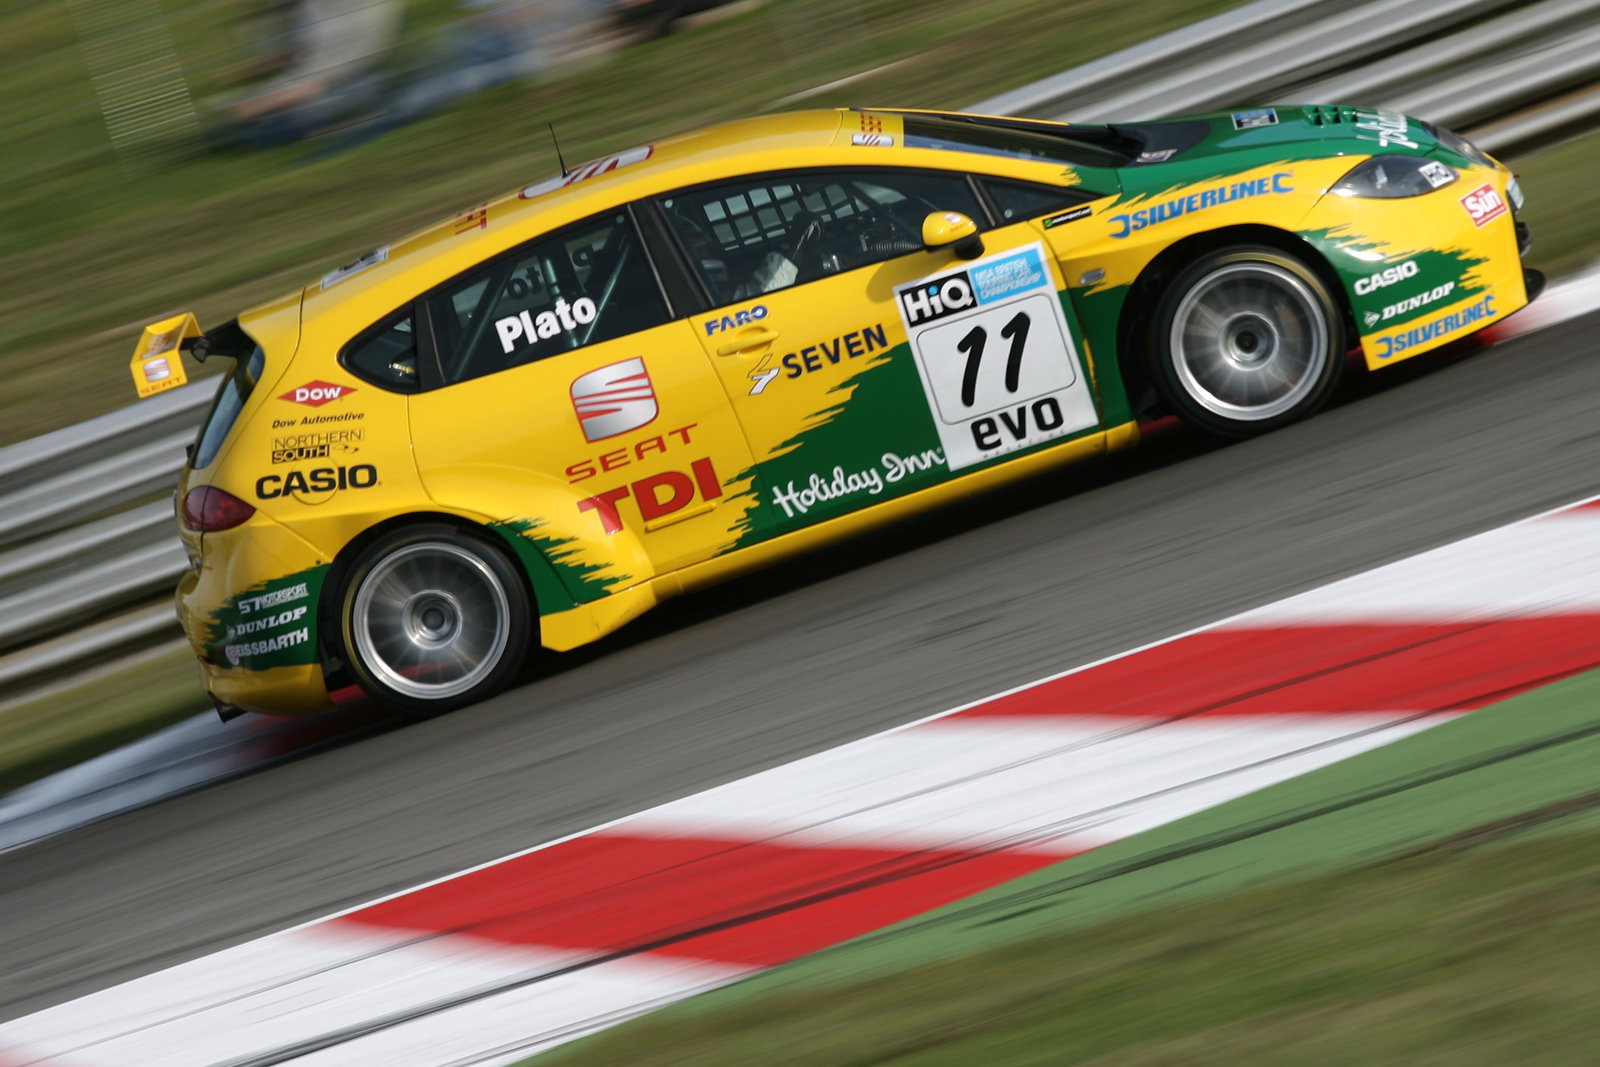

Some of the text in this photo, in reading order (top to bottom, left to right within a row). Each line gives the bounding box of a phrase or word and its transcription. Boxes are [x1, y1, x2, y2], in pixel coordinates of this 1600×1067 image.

[1464, 189, 1503, 219] Sun
[1354, 260, 1419, 296] CASIO
[903, 277, 973, 323] HiQ
[1381, 281, 1455, 321] DUNLOP
[495, 296, 597, 354] Plato
[704, 305, 768, 336] FARO
[781, 323, 888, 379] SEVEN
[957, 311, 1031, 407] 11
[272, 412, 364, 429] Dow Automotive
[274, 428, 362, 449] NORTHERN
[970, 397, 1064, 450] evo
[273, 445, 329, 463] SOUTH
[565, 423, 698, 484] SEAT
[255, 464, 377, 500] CASIO
[576, 456, 723, 536] TDI
[772, 449, 946, 518] Holiday Inn
[236, 605, 308, 636] DUNLOP
